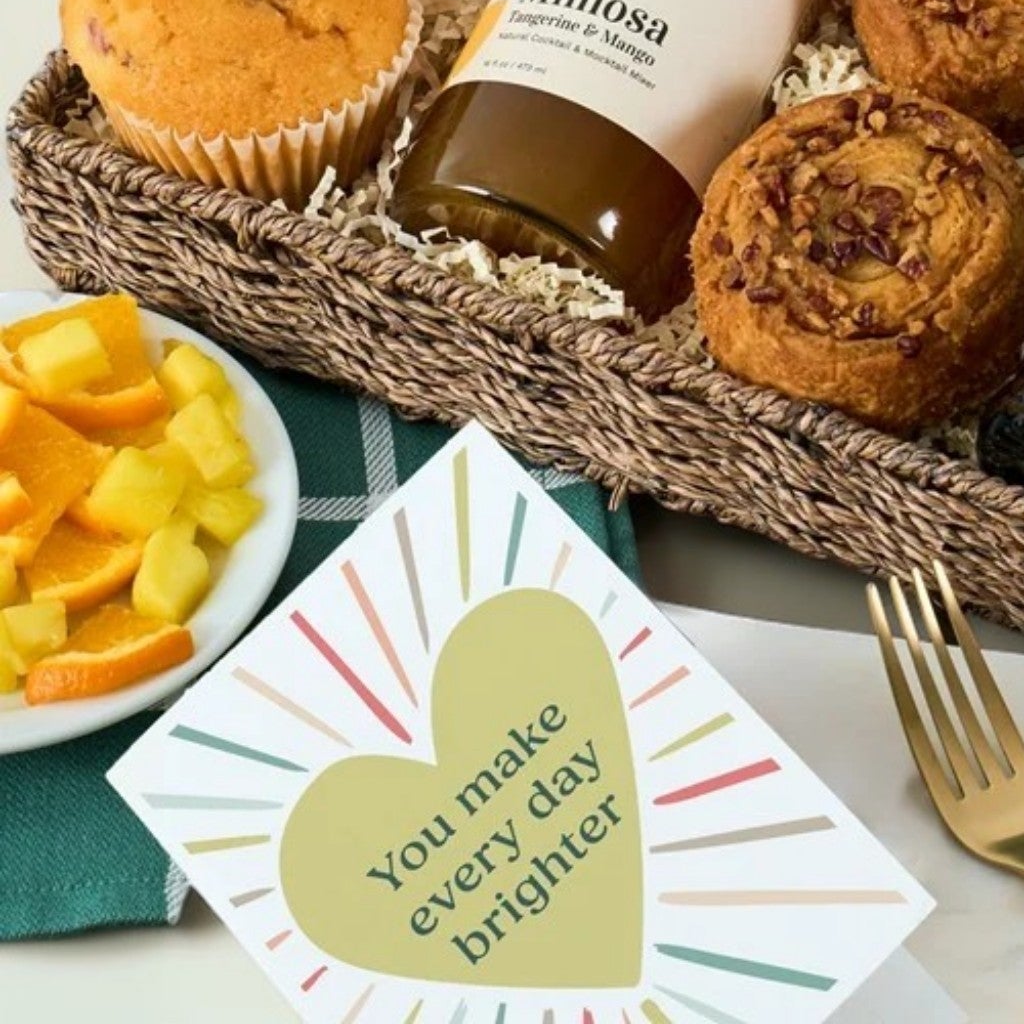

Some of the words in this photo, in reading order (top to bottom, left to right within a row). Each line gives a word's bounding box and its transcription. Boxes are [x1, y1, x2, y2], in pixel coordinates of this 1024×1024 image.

[507, 10, 581, 33] Tangerine
[583, 22, 599, 37] &
[600, 30, 656, 68] Mango
[366, 814, 457, 892] You
[455, 704, 567, 816] make
[411, 818, 520, 936] every
[528, 739, 601, 820] day
[451, 794, 621, 965] brighter
